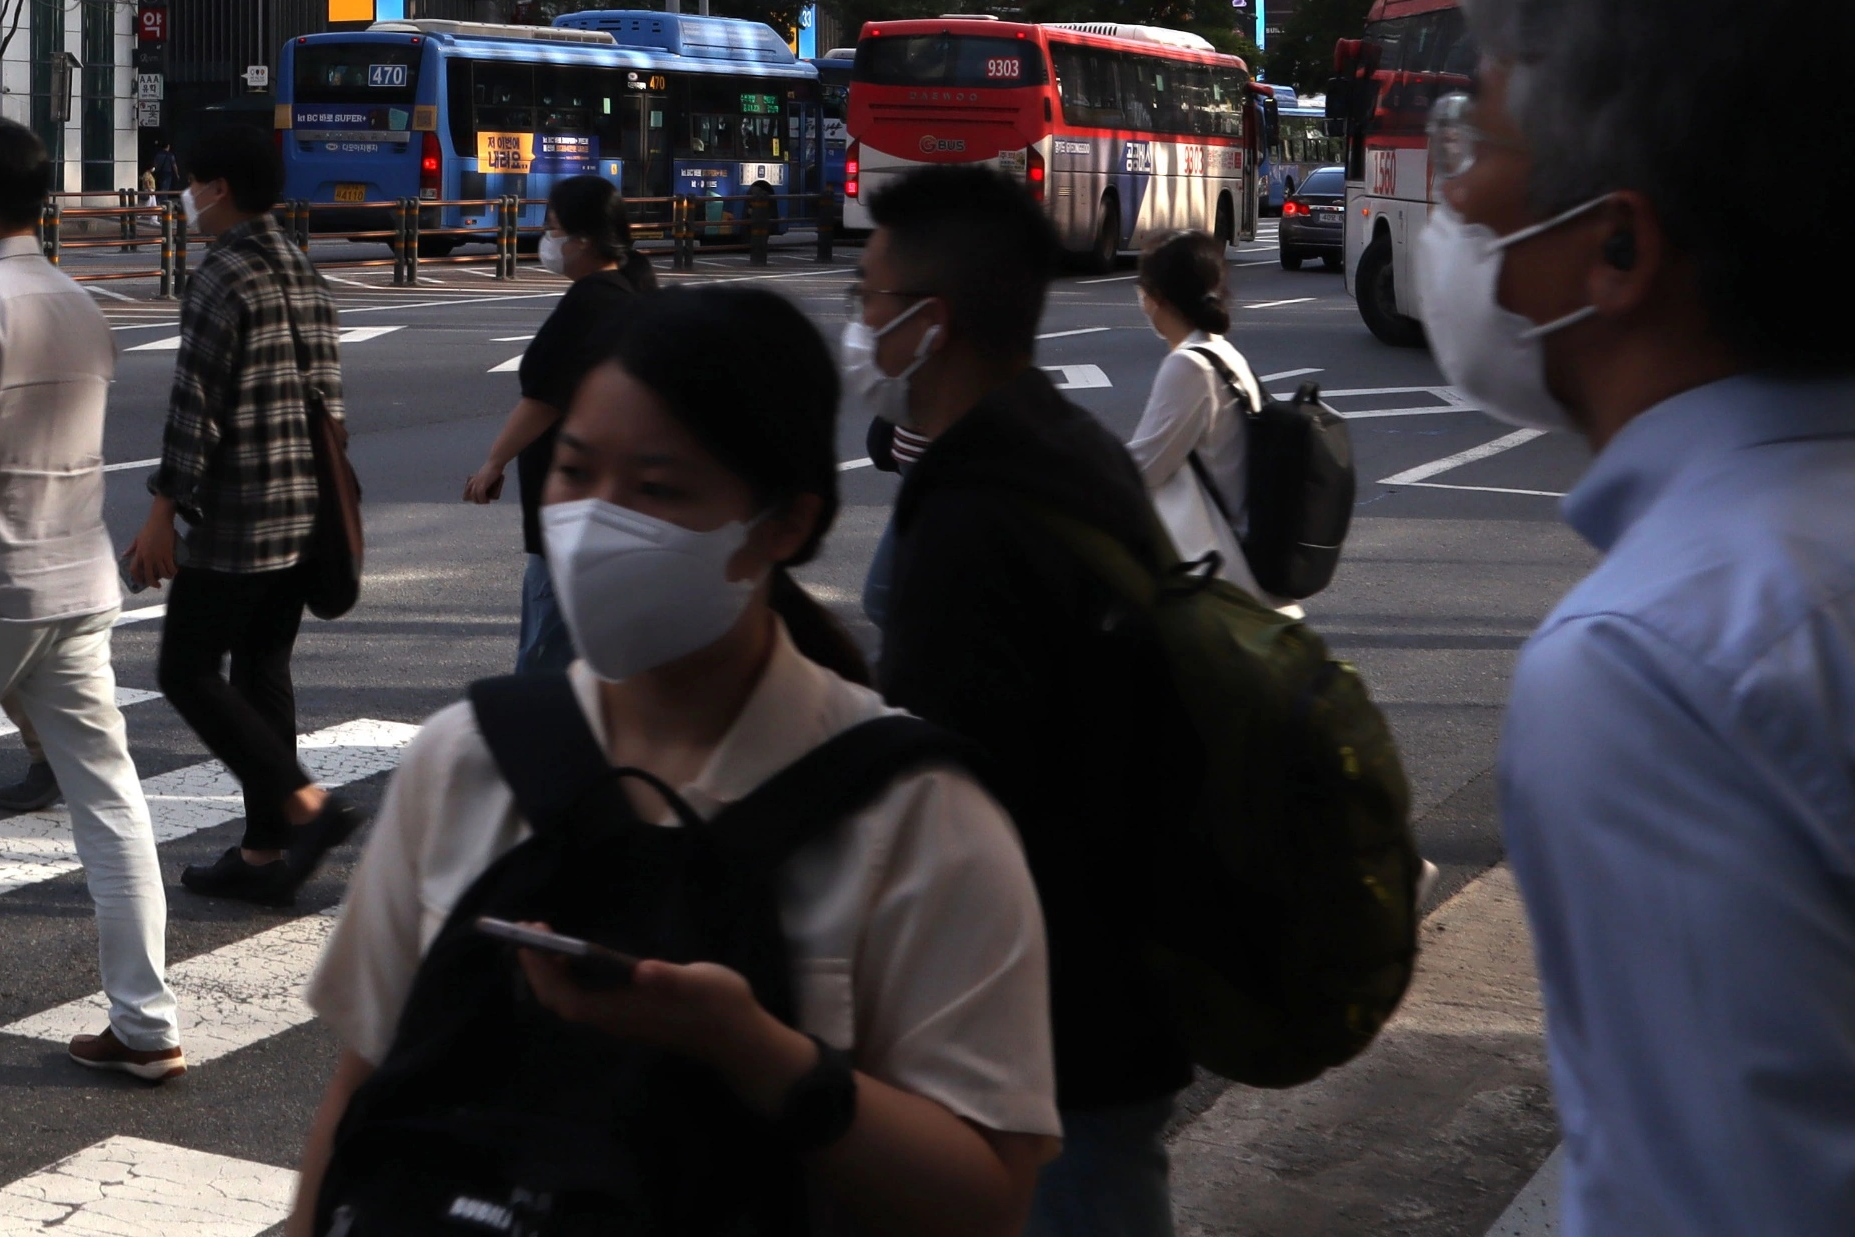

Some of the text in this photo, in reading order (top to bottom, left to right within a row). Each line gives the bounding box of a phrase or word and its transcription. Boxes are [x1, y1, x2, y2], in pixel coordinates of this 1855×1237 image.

[143, 11, 162, 38] 약
[801, 10, 812, 27] 33
[372, 66, 403, 85] 470
[988, 59, 1019, 76] 9303
[139, 74, 159, 83] AAA
[649, 75, 665, 91] 470
[909, 92, 978, 102] DAEWOO
[307, 114, 318, 123] BC
[334, 114, 367, 123] SUPER+
[497, 136, 520, 150] 이번에
[1184, 146, 1204, 175] 9303
[1374, 151, 1397, 195] 1560
